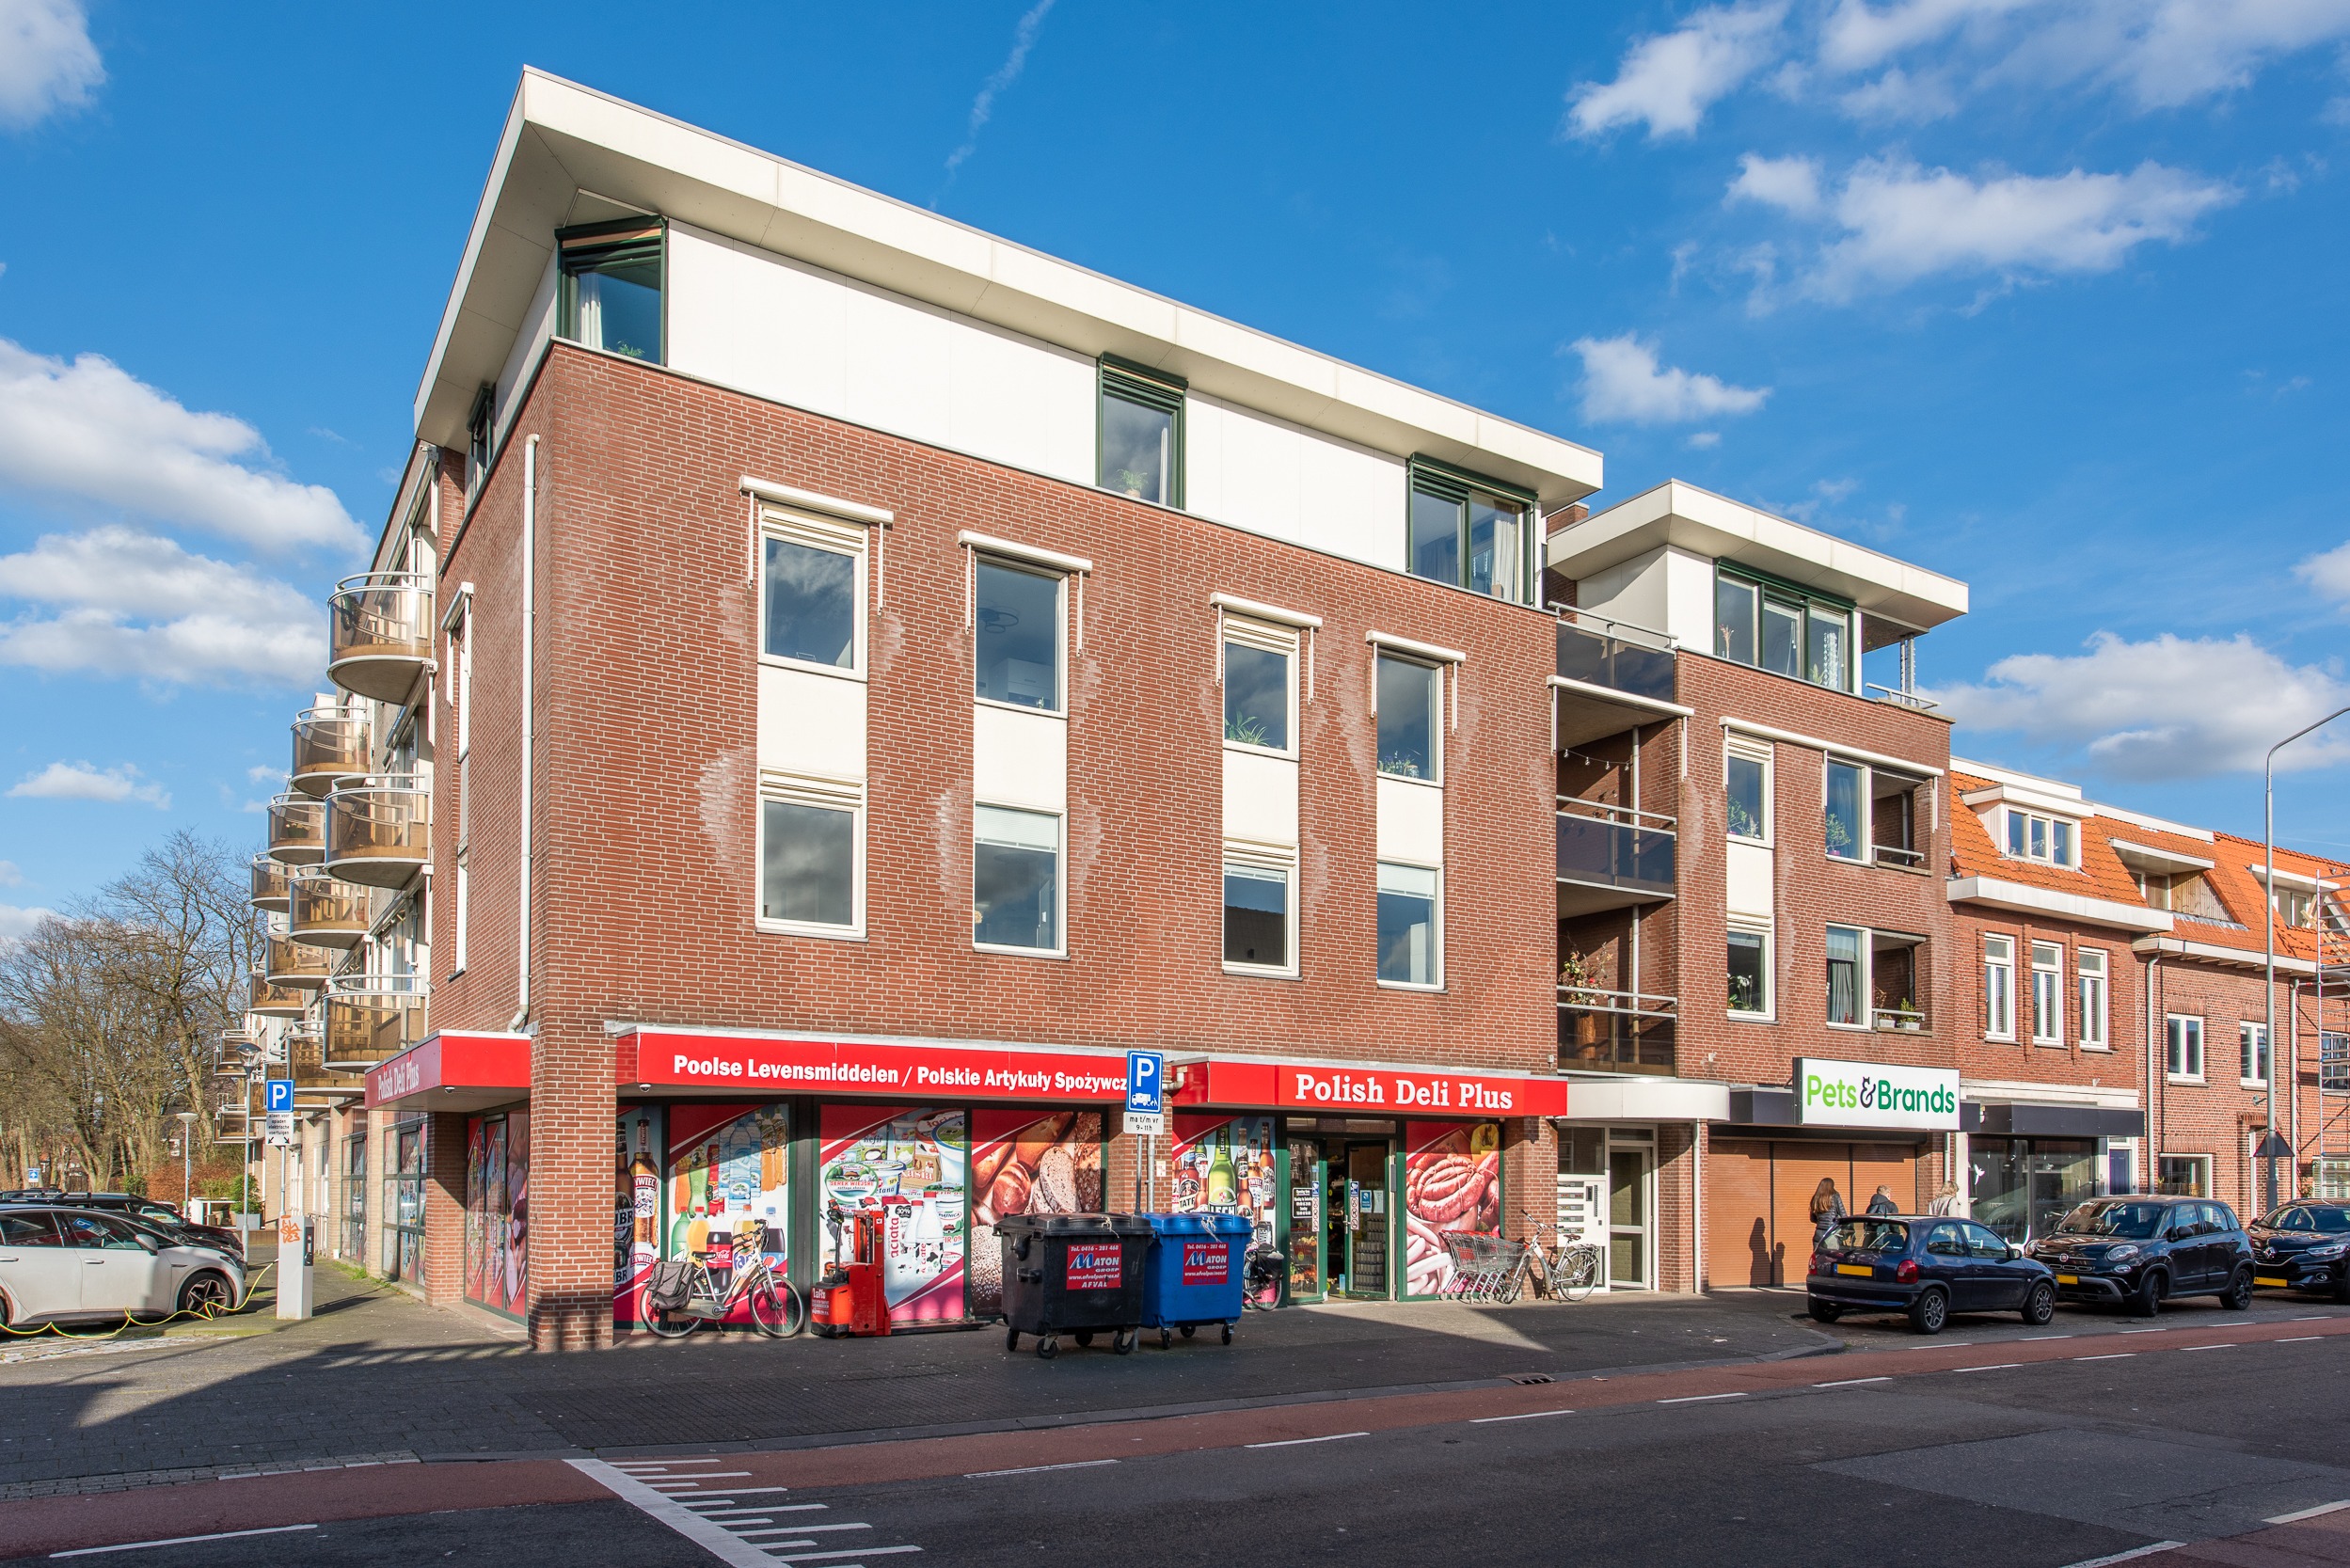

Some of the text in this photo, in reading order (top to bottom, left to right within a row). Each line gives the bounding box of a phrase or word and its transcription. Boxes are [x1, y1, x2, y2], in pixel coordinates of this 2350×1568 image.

[378, 1060, 419, 1101] Polish Deli Plus
[674, 1054, 742, 1077] Poolse
[748, 1058, 898, 1084] Levensmiddelen
[917, 1067, 980, 1086] Polskie
[984, 1069, 1051, 1091] Artykuły
[1136, 1058, 1155, 1087] P
[272, 1084, 287, 1109] P
[1294, 1073, 1513, 1110] Polish Deli Plus
[1807, 1075, 1857, 1109] Pets
[1878, 1079, 1955, 1114] Brands
[1140, 1115, 1151, 1123] t/m
